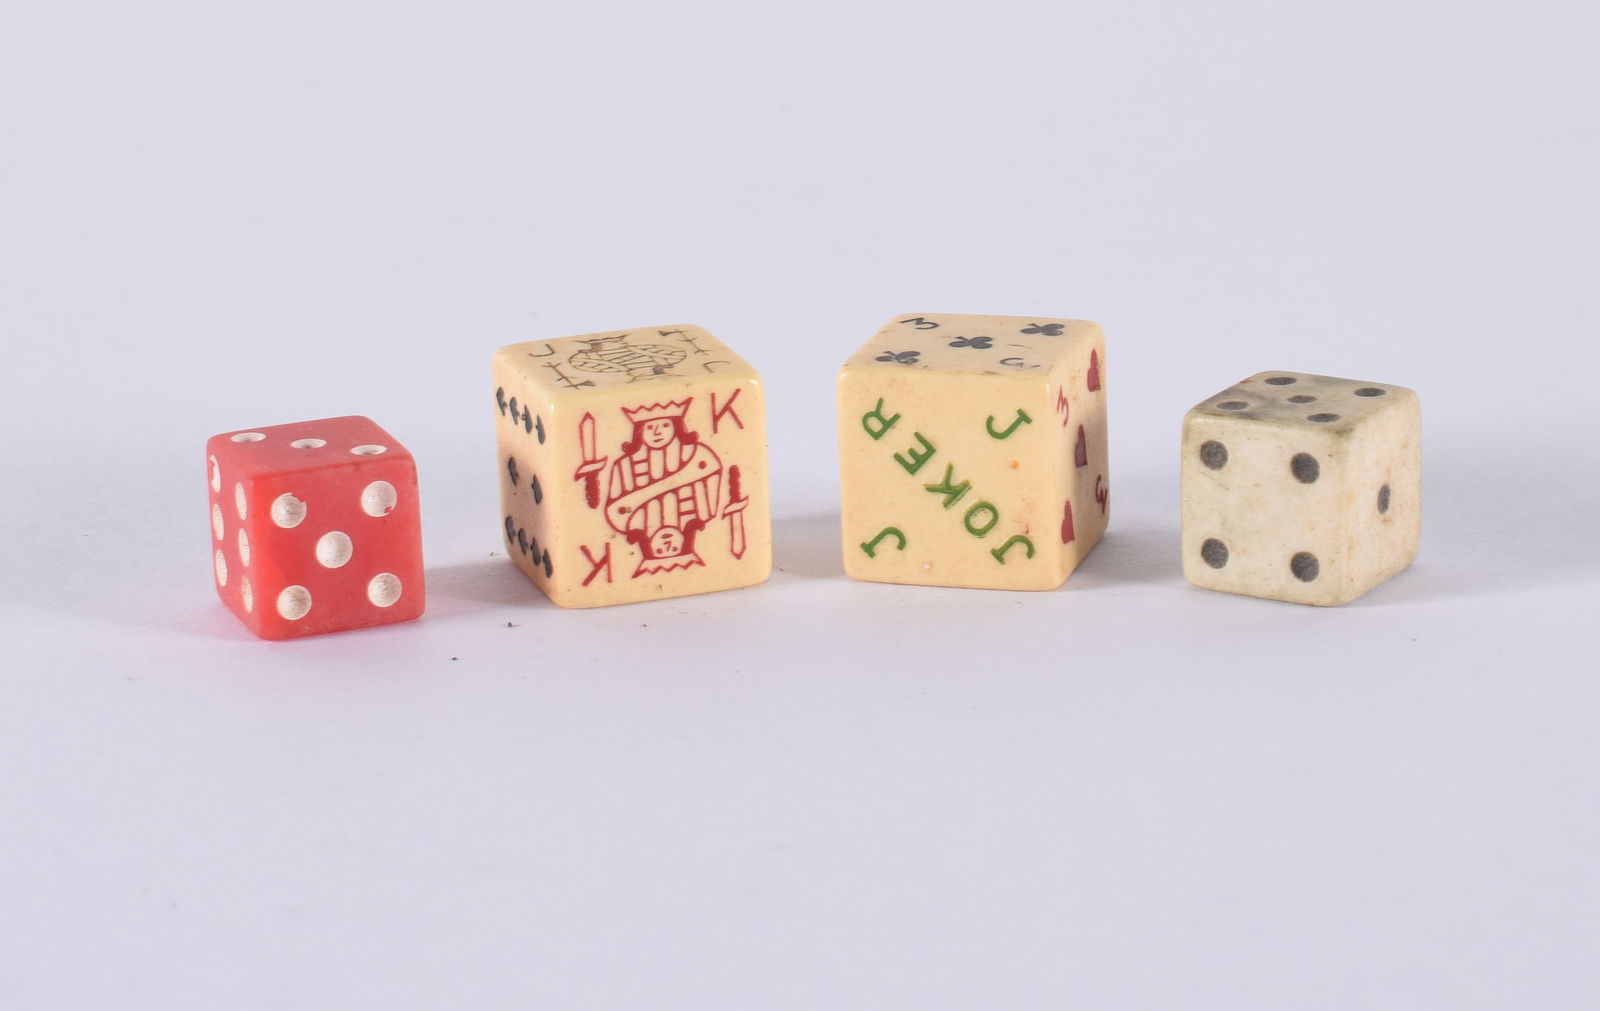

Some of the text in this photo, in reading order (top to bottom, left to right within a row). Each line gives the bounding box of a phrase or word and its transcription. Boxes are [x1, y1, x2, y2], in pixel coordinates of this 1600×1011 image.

[899, 317, 940, 330] 3
[711, 388, 745, 433] K
[985, 408, 1033, 440] J
[862, 397, 1036, 565] JOKER
[860, 526, 907, 559] J
[580, 542, 613, 587] K
